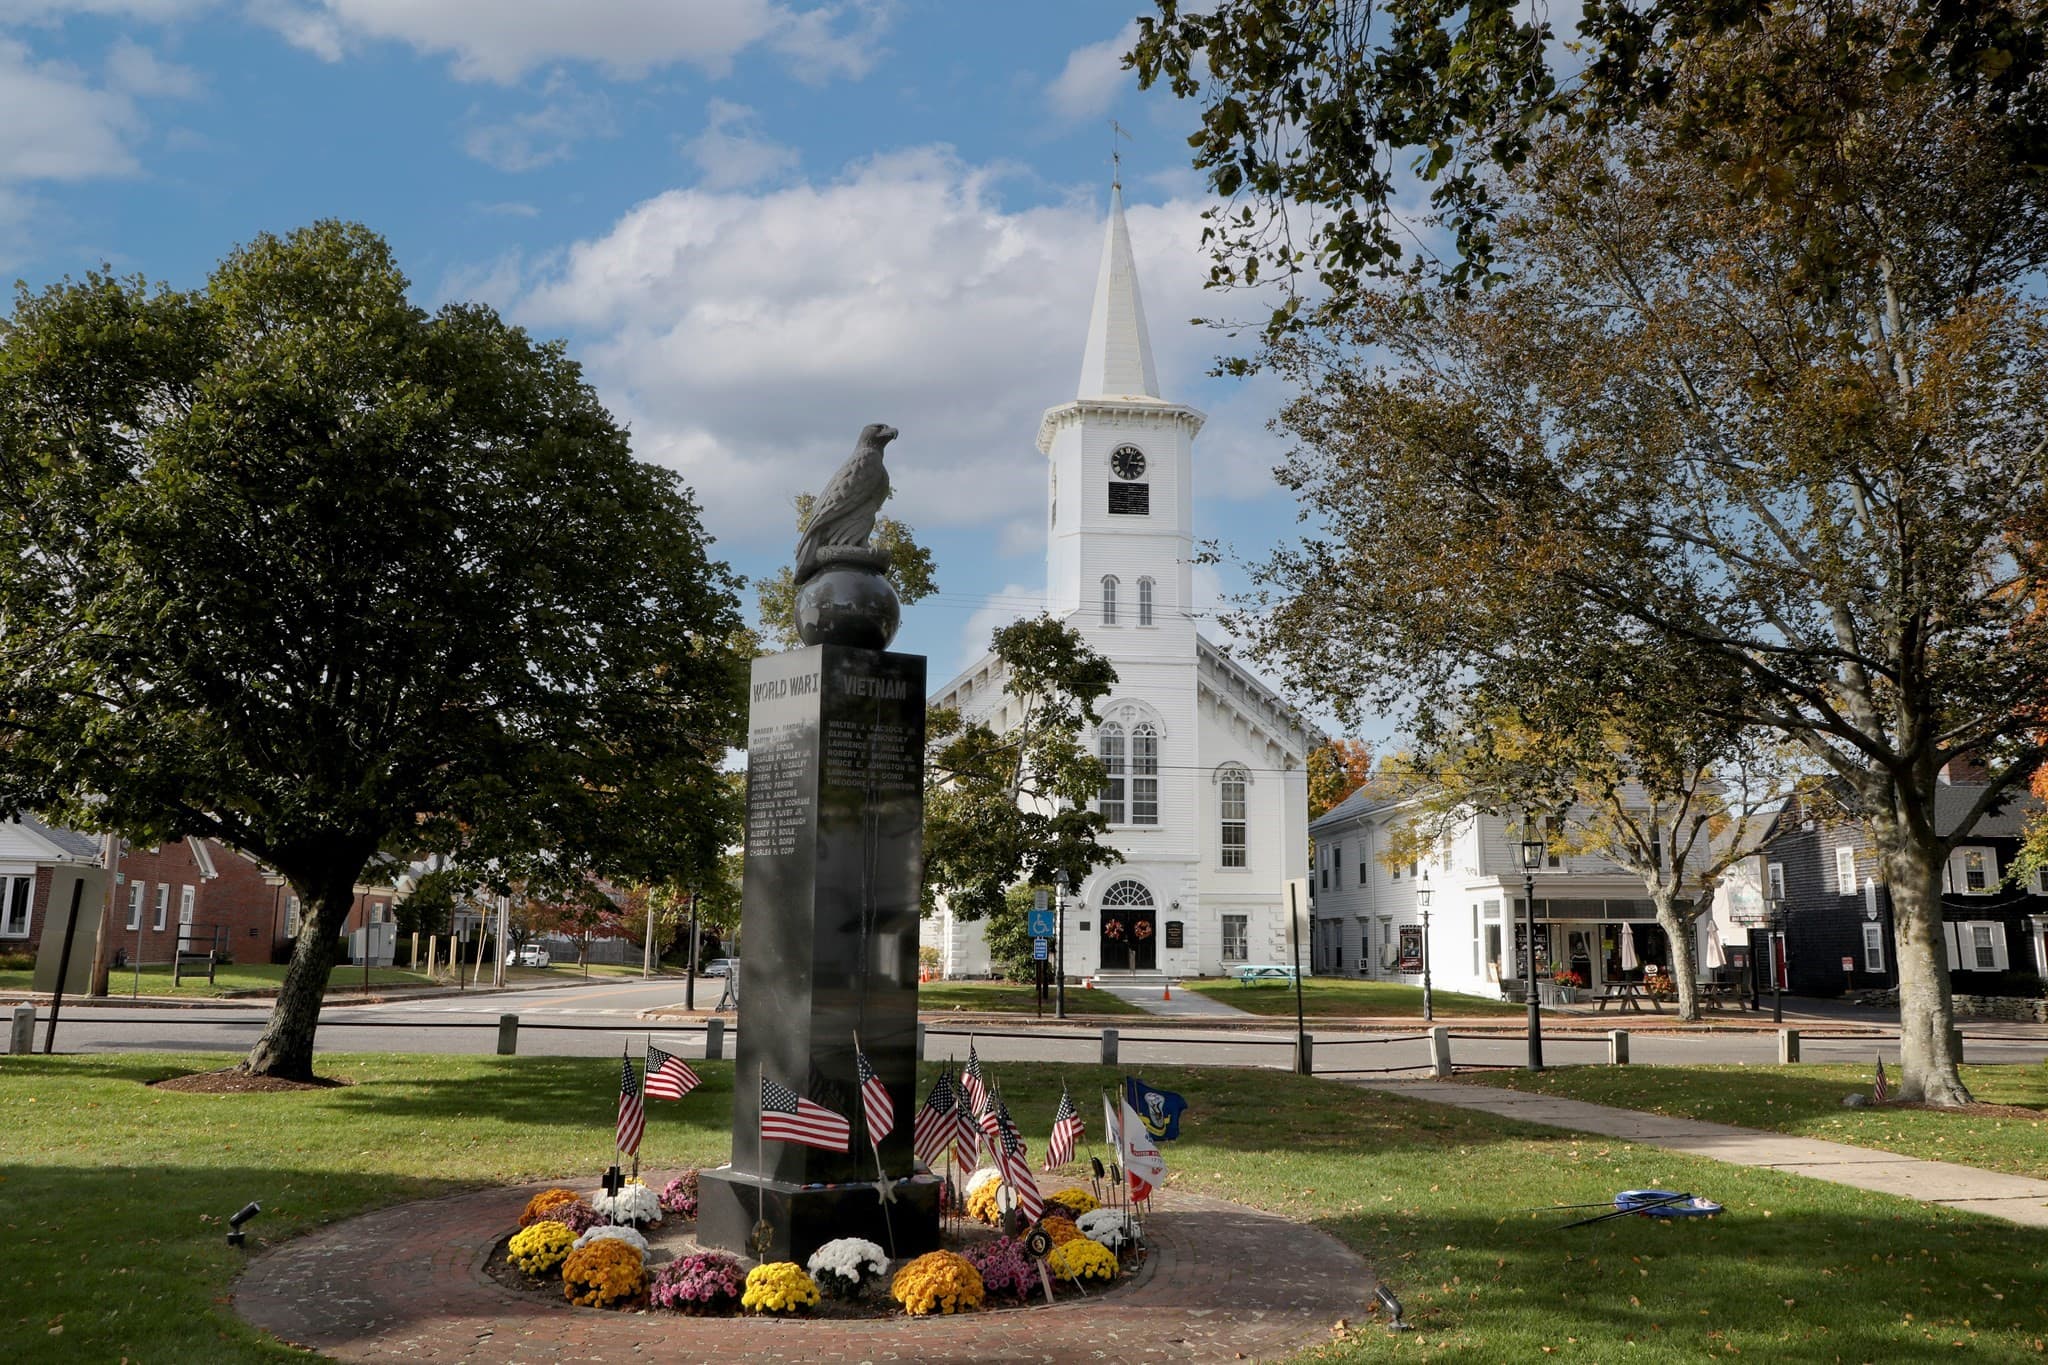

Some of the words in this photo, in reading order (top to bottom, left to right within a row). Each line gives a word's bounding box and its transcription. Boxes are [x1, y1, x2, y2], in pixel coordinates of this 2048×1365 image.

[753, 680, 787, 703] WORLD
[789, 675, 811, 696] WAR
[812, 673, 819, 692] I
[843, 675, 907, 699] VIETNAM
